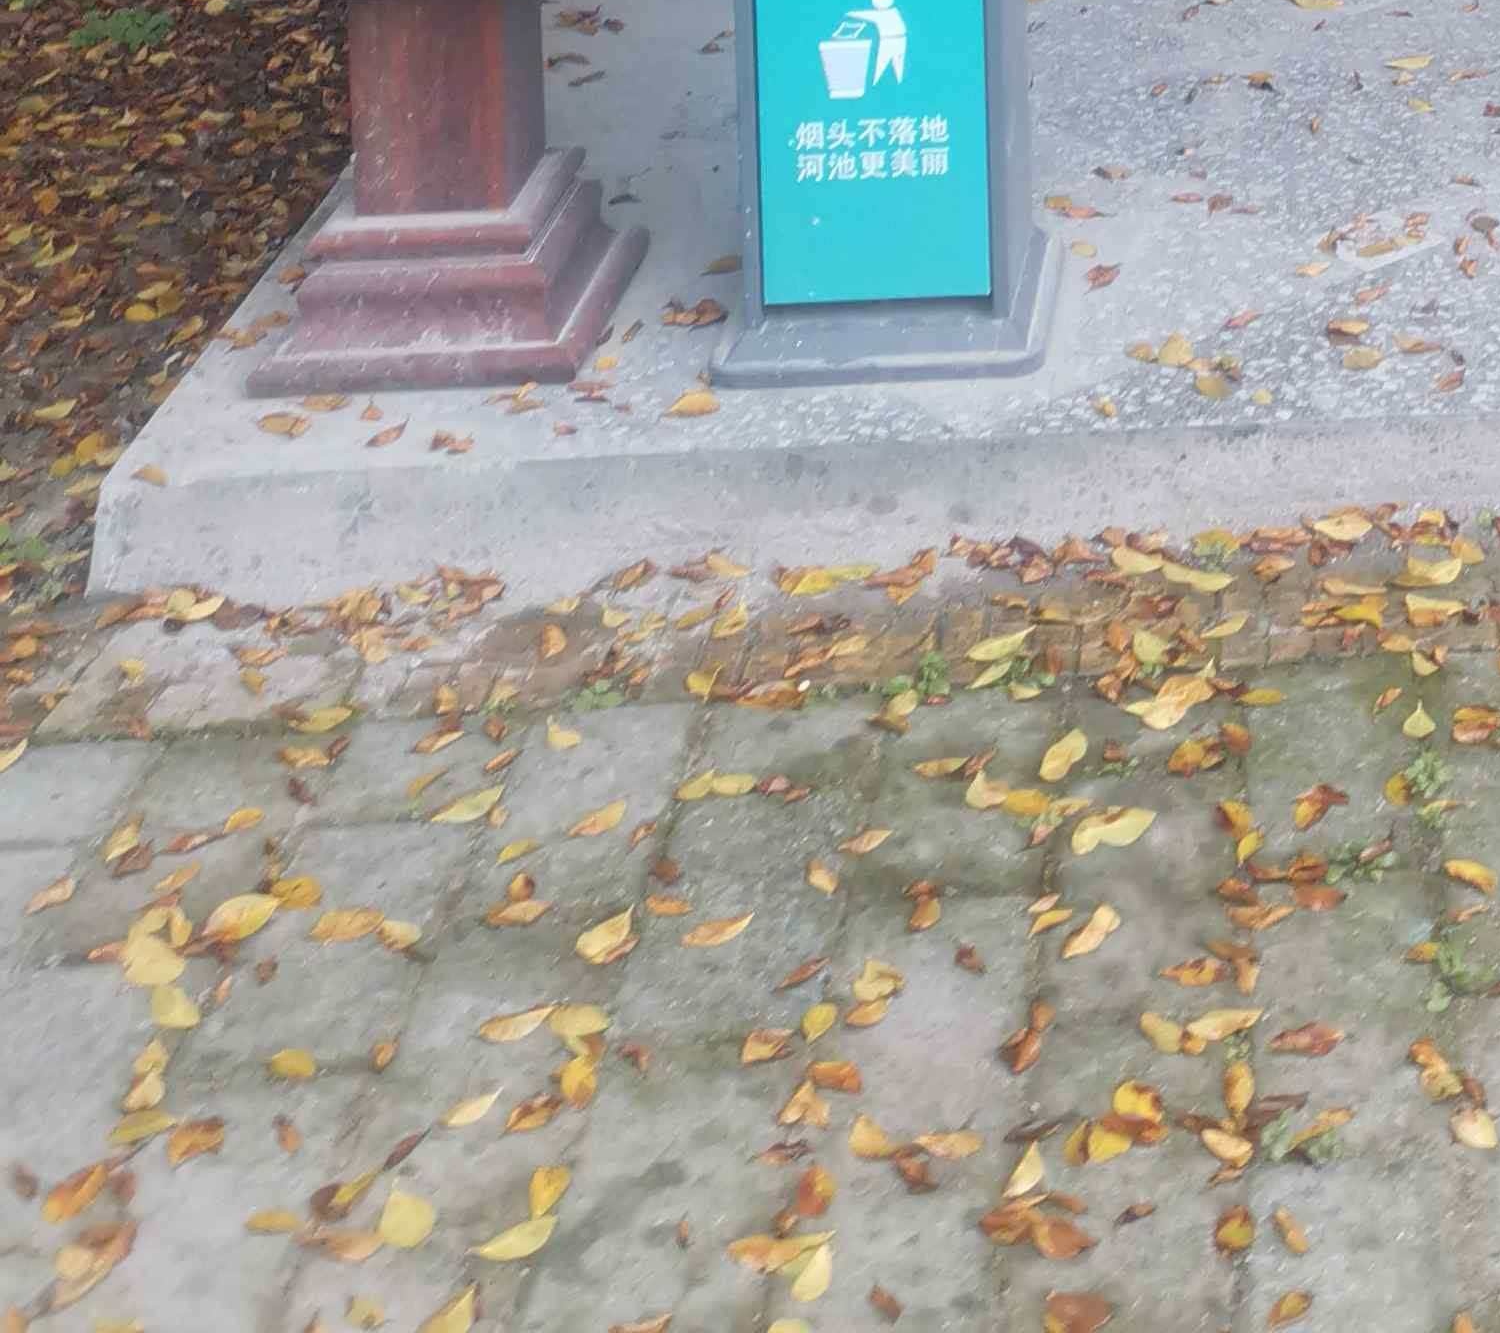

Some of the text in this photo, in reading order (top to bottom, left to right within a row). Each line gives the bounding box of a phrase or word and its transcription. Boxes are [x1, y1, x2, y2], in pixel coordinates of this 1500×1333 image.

[795, 113, 949, 150] 烟头不落地
[795, 146, 949, 182] 河池更美丽
